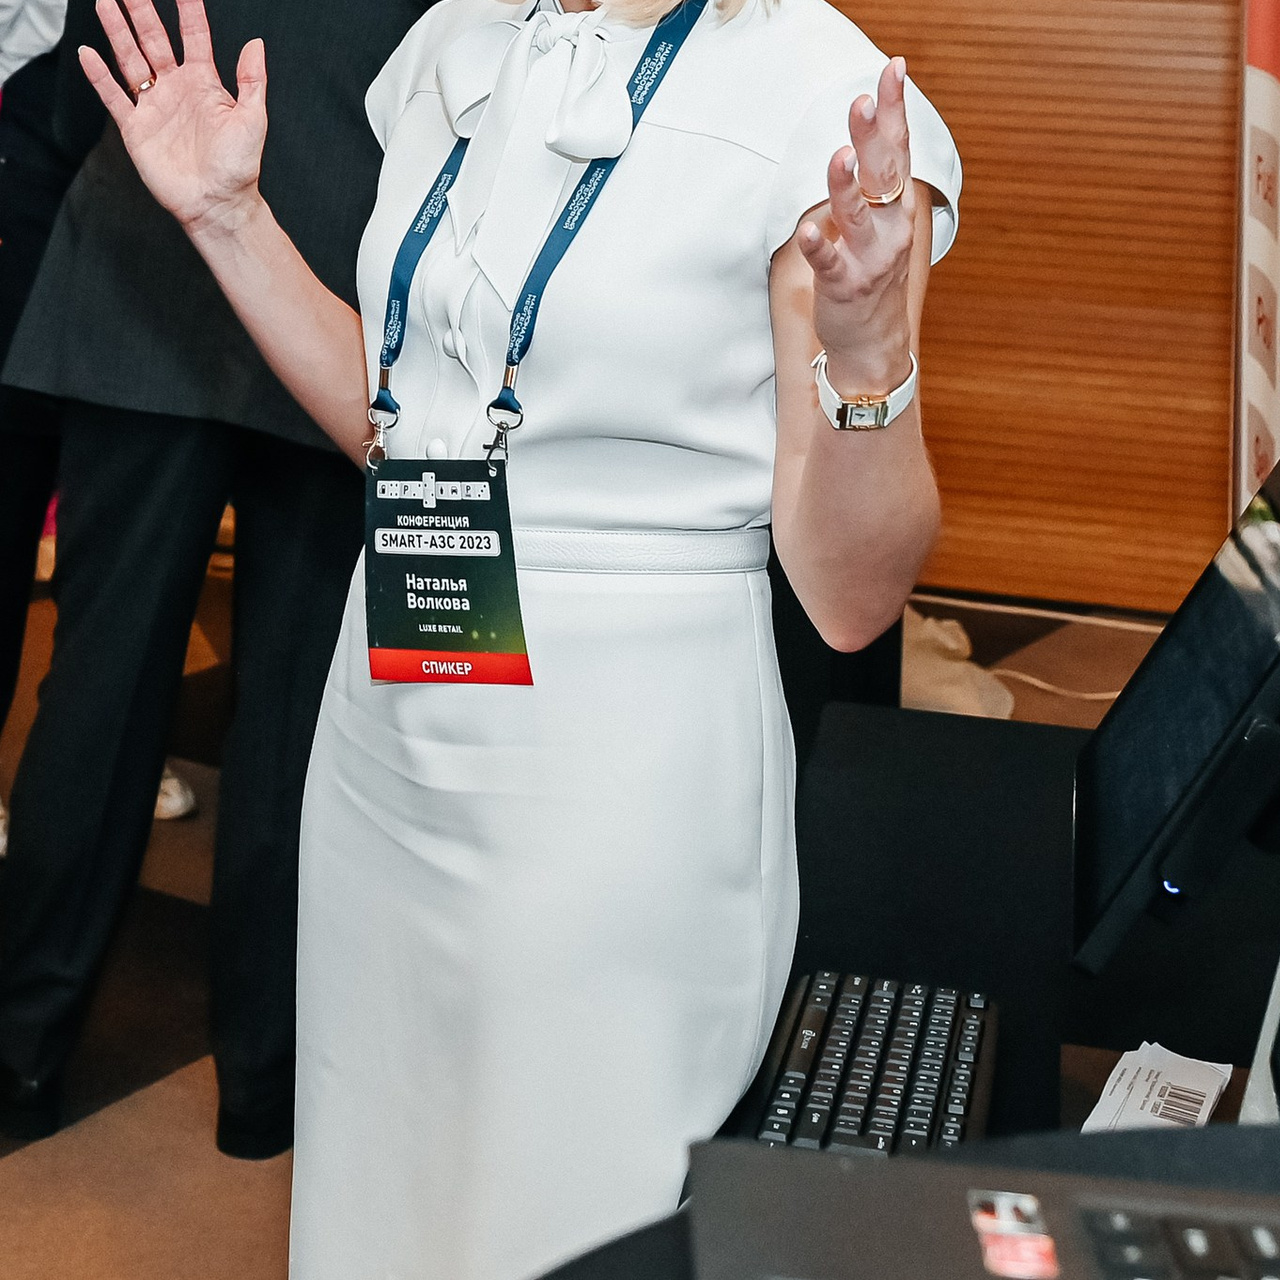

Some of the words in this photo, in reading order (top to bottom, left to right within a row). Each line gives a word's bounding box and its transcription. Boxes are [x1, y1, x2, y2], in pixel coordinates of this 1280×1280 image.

[631, 41, 667, 103] НЕФТЕГАЗОВЫЙ
[633, 56, 652, 84] ФОРУМ
[567, 183, 586, 210] ФОРУМ
[396, 514, 470, 529] КОНФЕРЕНЦИЯ
[459, 535, 492, 550] 2023
[405, 573, 468, 592] Наталья
[407, 592, 471, 611] Волкова
[418, 623, 437, 633] LUXE
[438, 624, 464, 634] RETAIL
[421, 660, 473, 676] СПИКЕР
